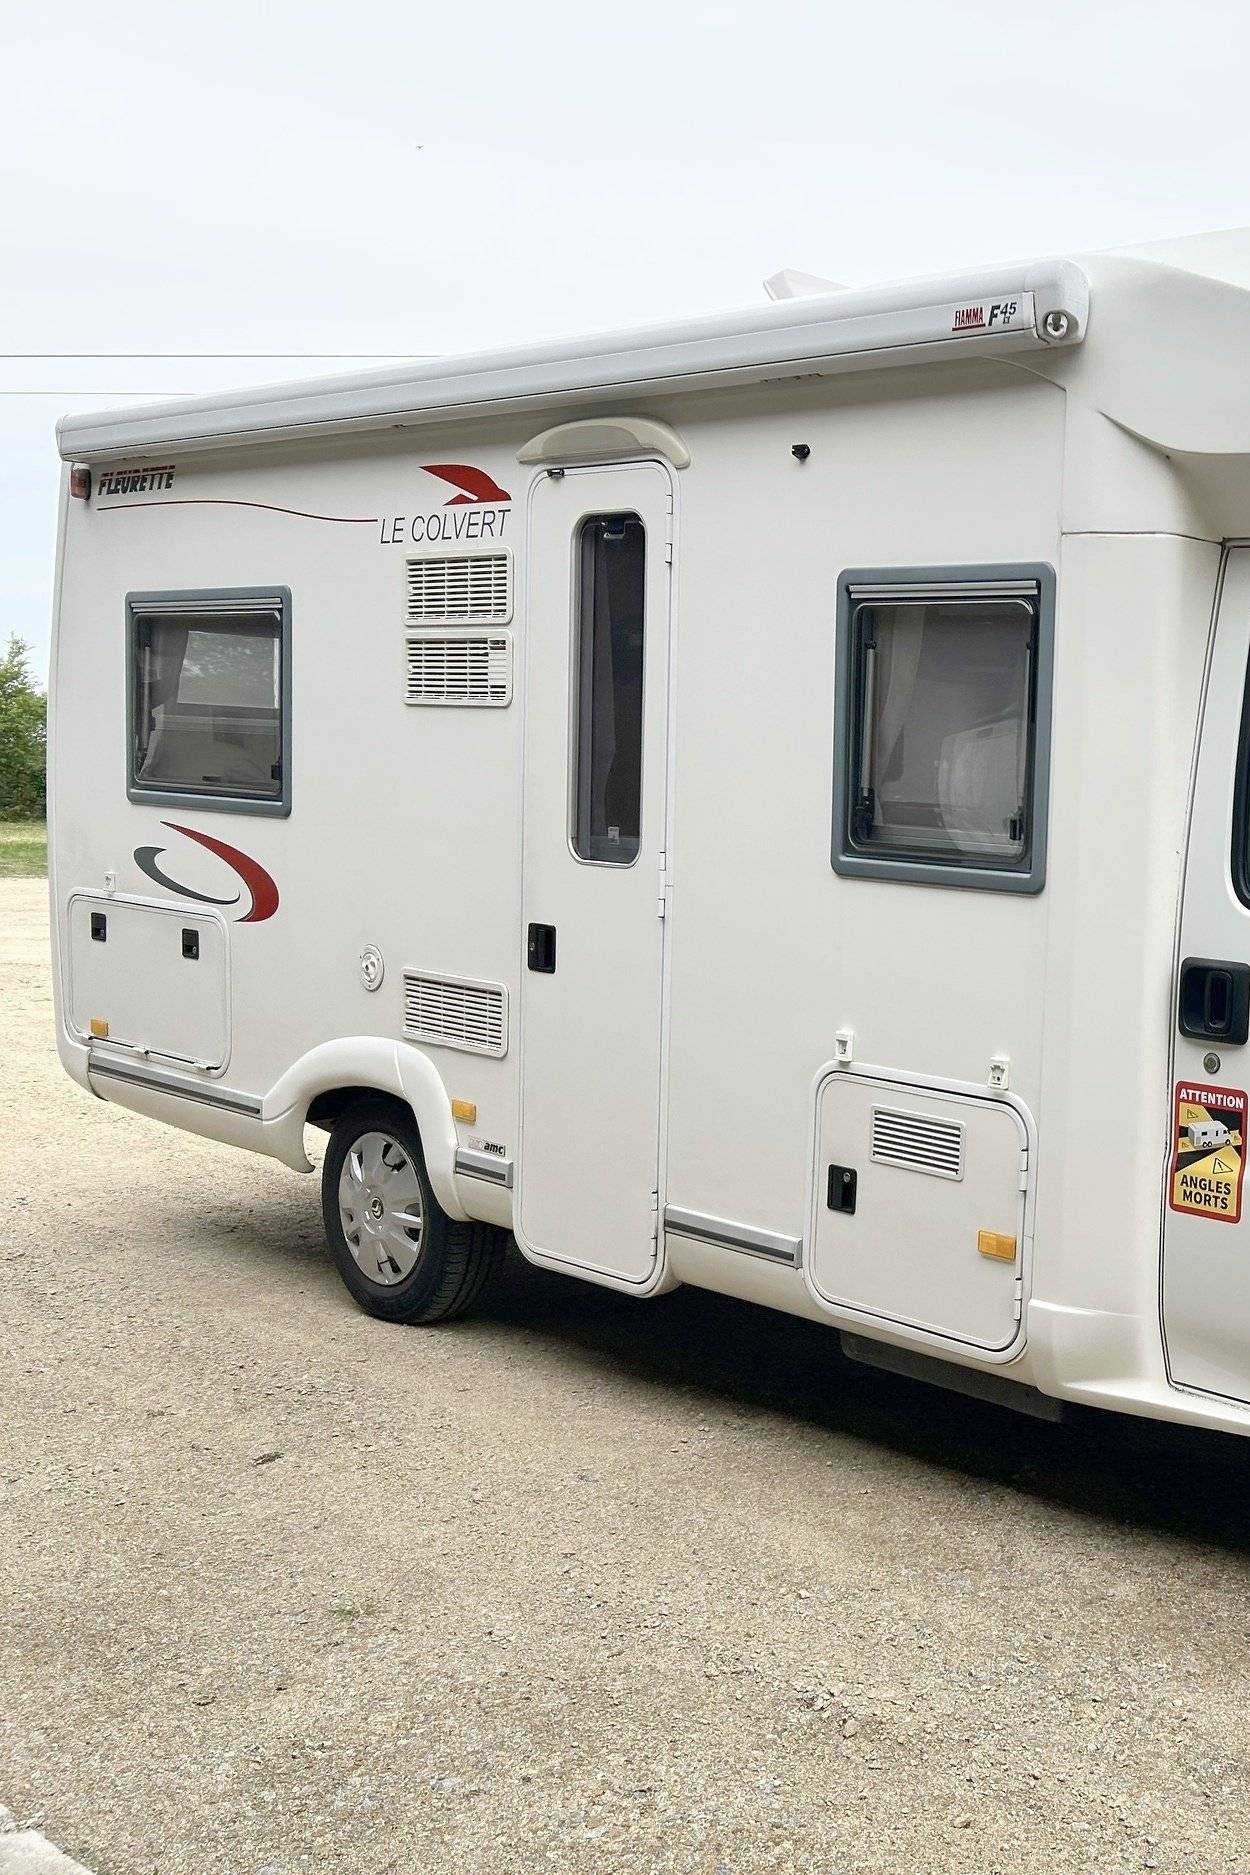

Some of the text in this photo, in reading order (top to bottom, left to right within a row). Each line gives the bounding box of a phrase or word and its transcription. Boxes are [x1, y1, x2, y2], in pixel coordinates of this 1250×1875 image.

[954, 301, 1017, 327] FIAMMA F45
[97, 471, 176, 496] FLEURETTE
[380, 508, 512, 545] LE COLVERT
[1179, 1087, 1245, 1110] ATTENTION
[1179, 1173, 1232, 1196] ANGLES
[1182, 1188, 1230, 1211] MORTS
